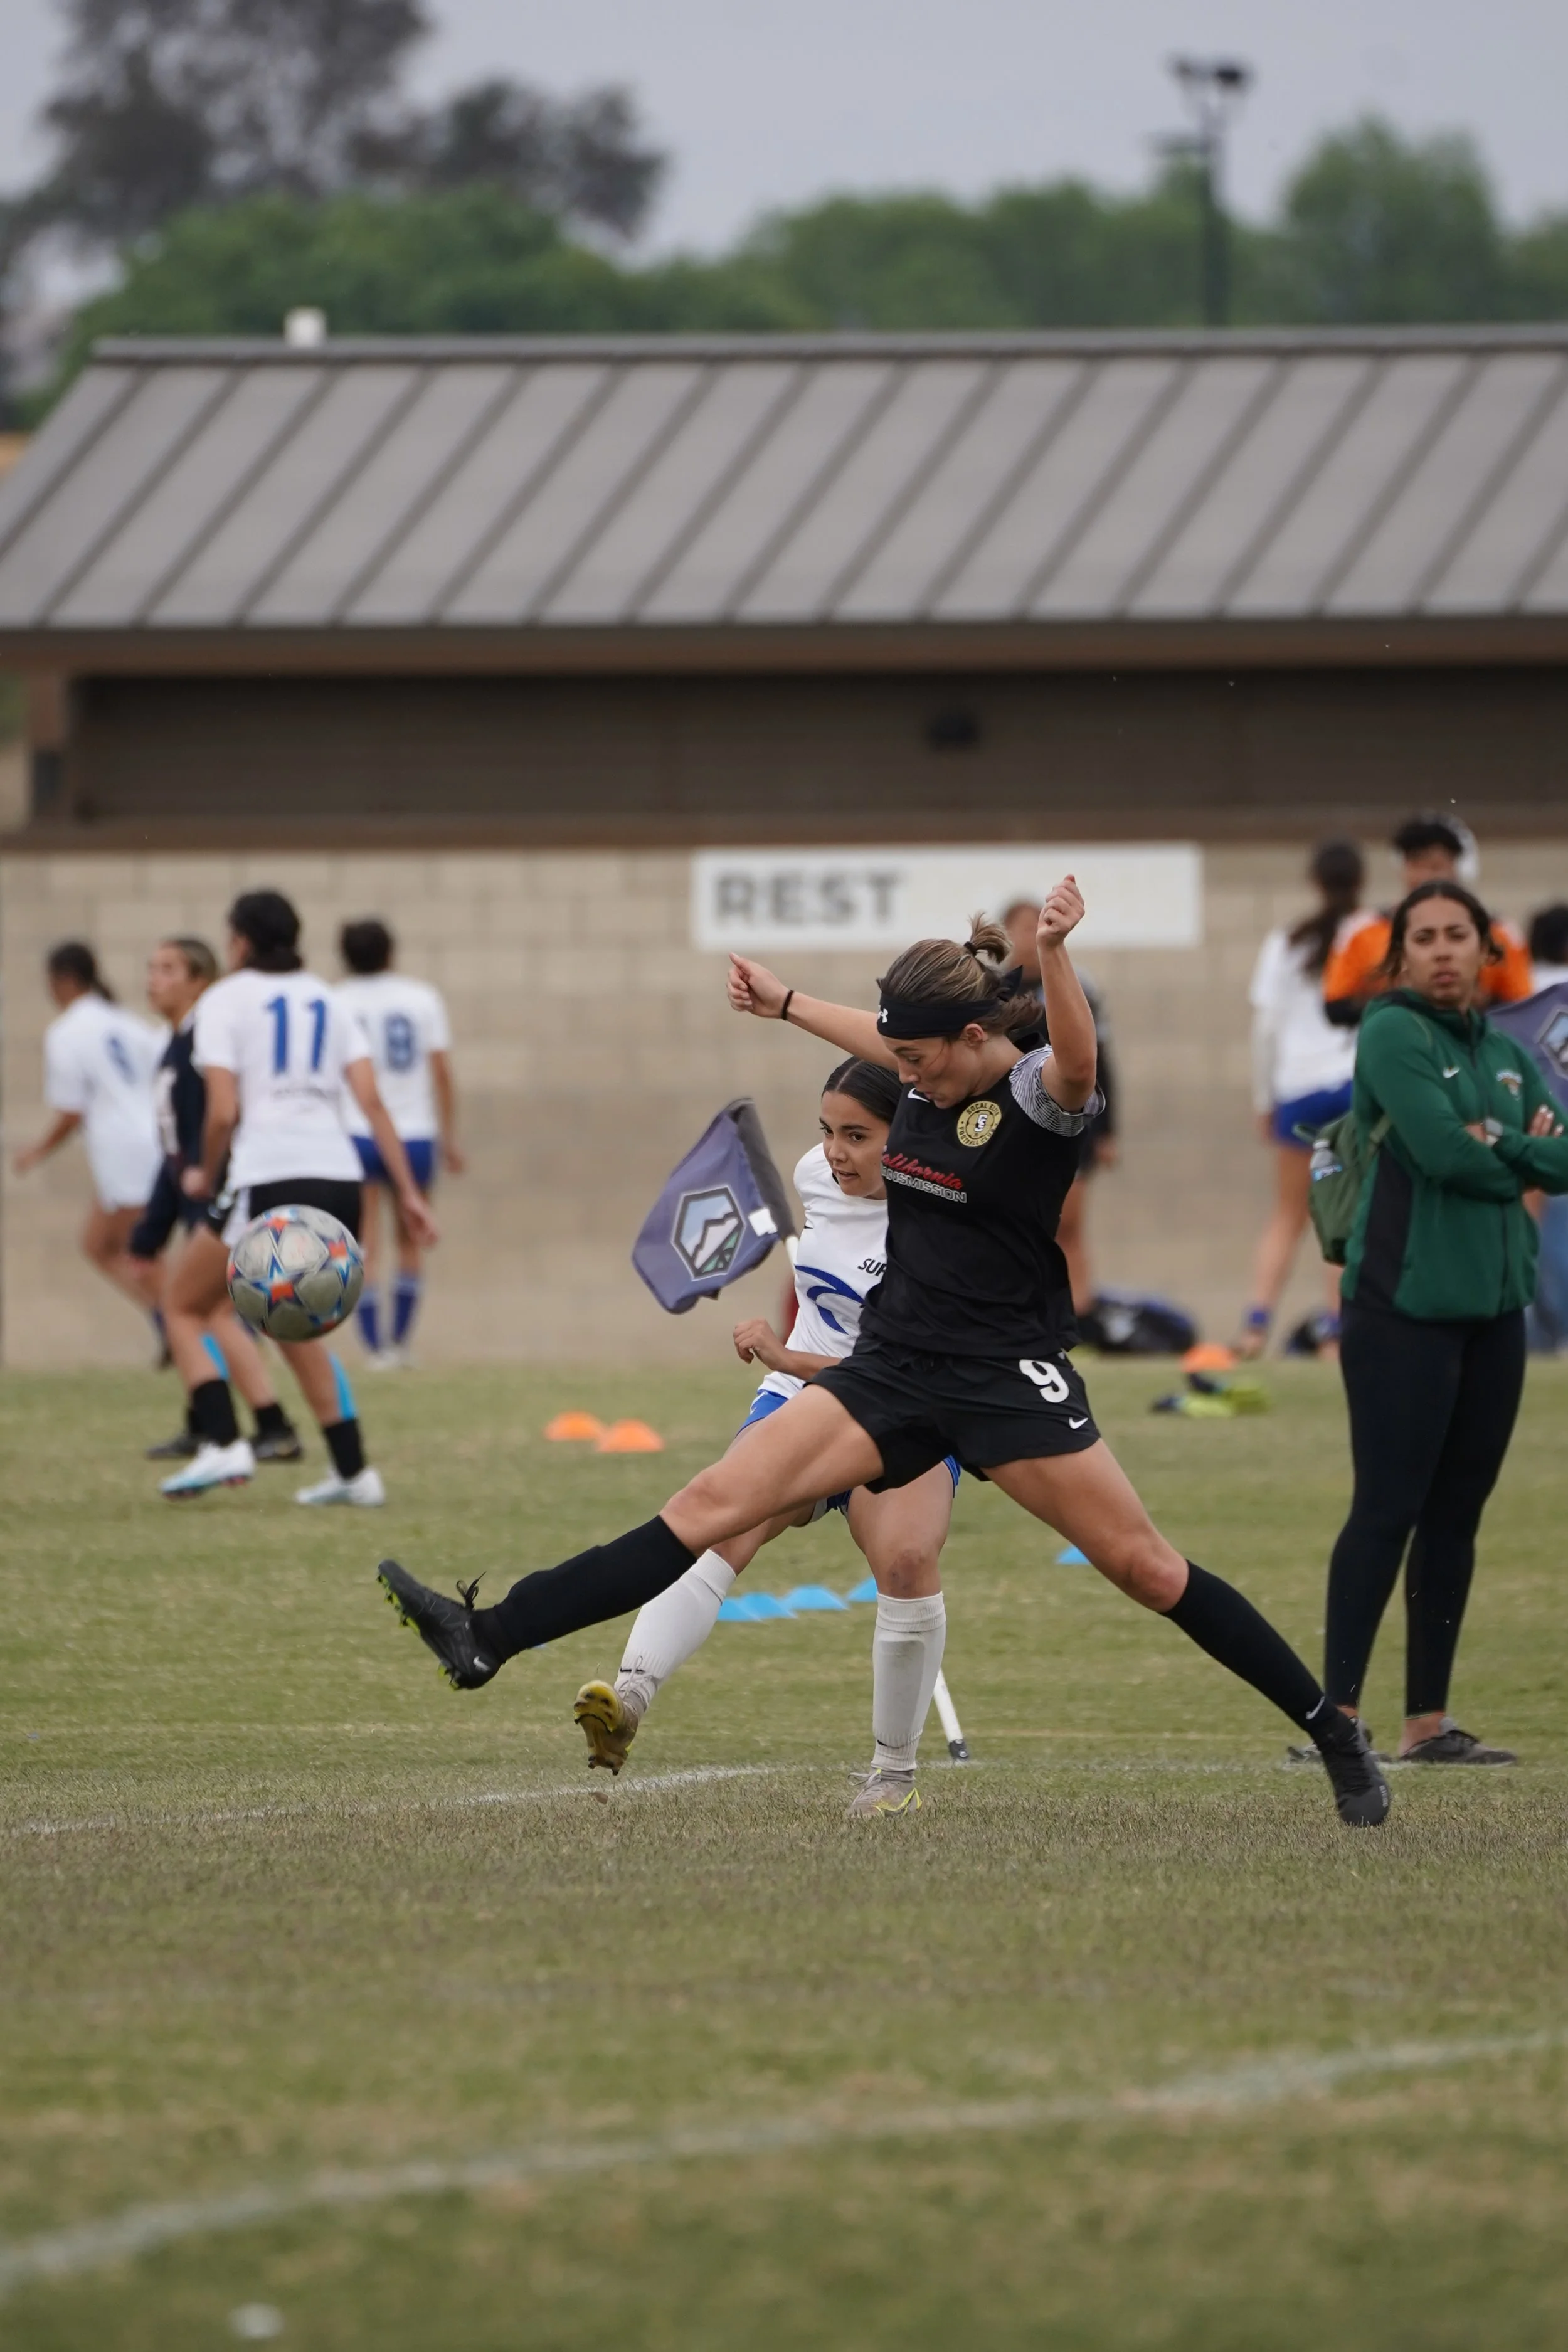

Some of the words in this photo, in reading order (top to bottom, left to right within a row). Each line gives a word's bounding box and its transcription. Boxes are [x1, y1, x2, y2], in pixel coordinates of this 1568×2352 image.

[716, 868, 899, 927] REST
[265, 995, 326, 1075] 11
[967, 1103, 988, 1115] SOCAL
[882, 1153, 964, 1190] alifornia
[1019, 1359, 1069, 1403] 9
